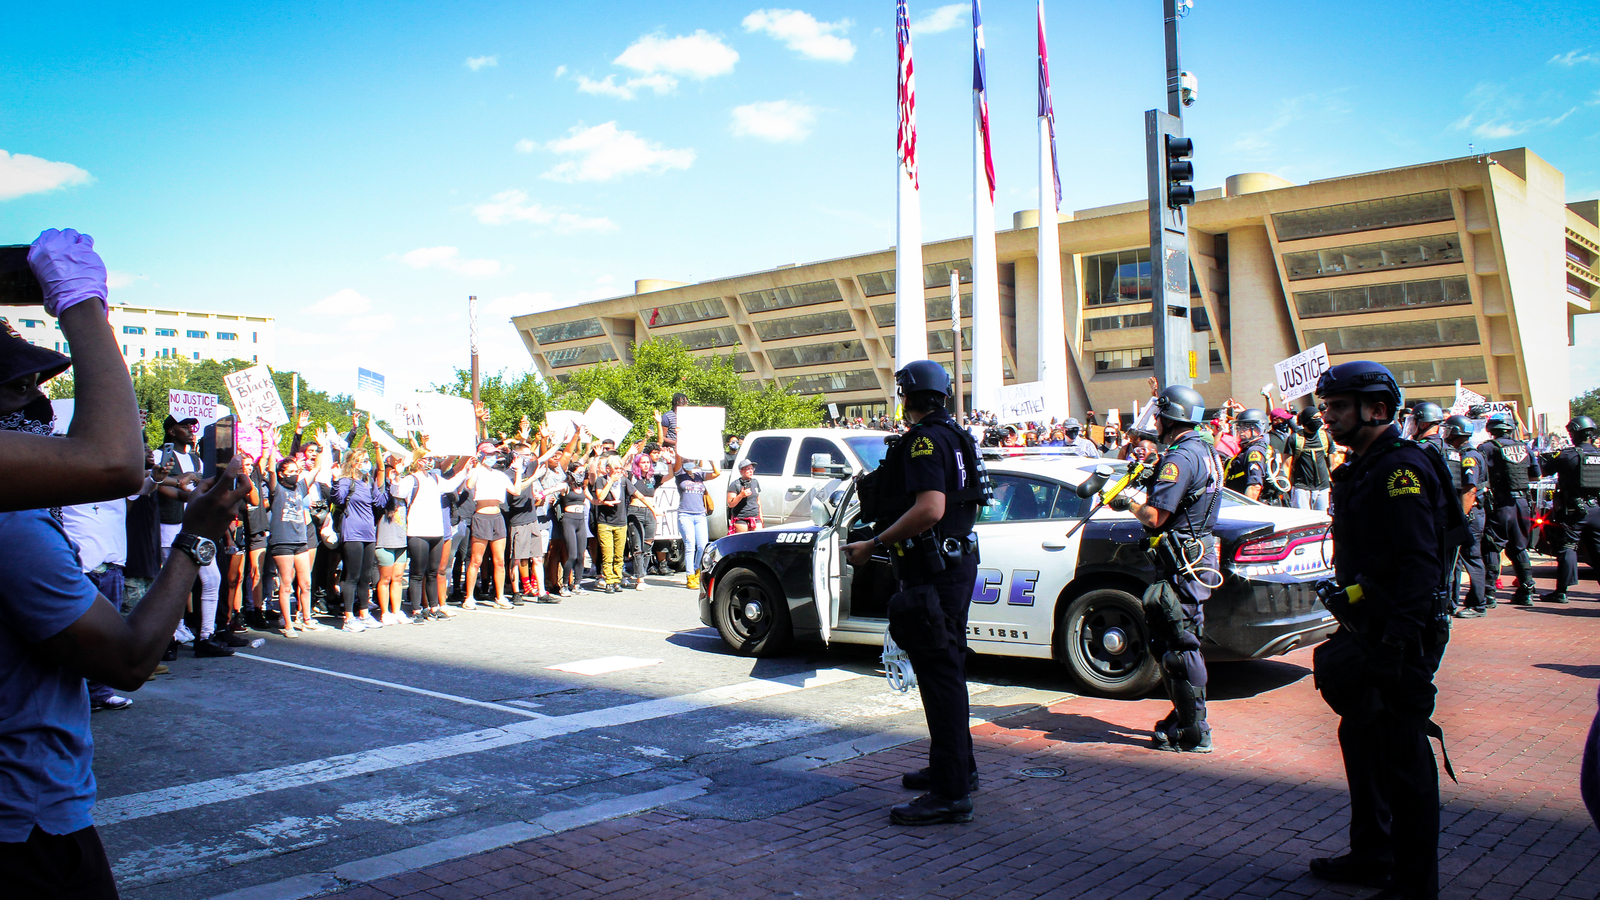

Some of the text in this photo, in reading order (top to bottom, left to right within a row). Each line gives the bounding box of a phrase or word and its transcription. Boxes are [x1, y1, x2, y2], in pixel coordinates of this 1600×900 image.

[1279, 348, 1317, 371] THE EYES OF
[226, 371, 252, 388] Let
[1280, 355, 1325, 391] JUSTICE
[236, 378, 274, 398] Blacks
[263, 390, 274, 401] in
[1287, 381, 1316, 397] ARE WATC
[170, 393, 217, 408] NO JUSTICE
[1001, 395, 1045, 419] BREATHE!
[189, 406, 213, 419] PEACE
[1387, 469, 1421, 489] DALLAS POLICE
[1388, 486, 1421, 497] DEPARTMENT
[775, 532, 814, 544] 9013
[988, 628, 1029, 640] 1881
